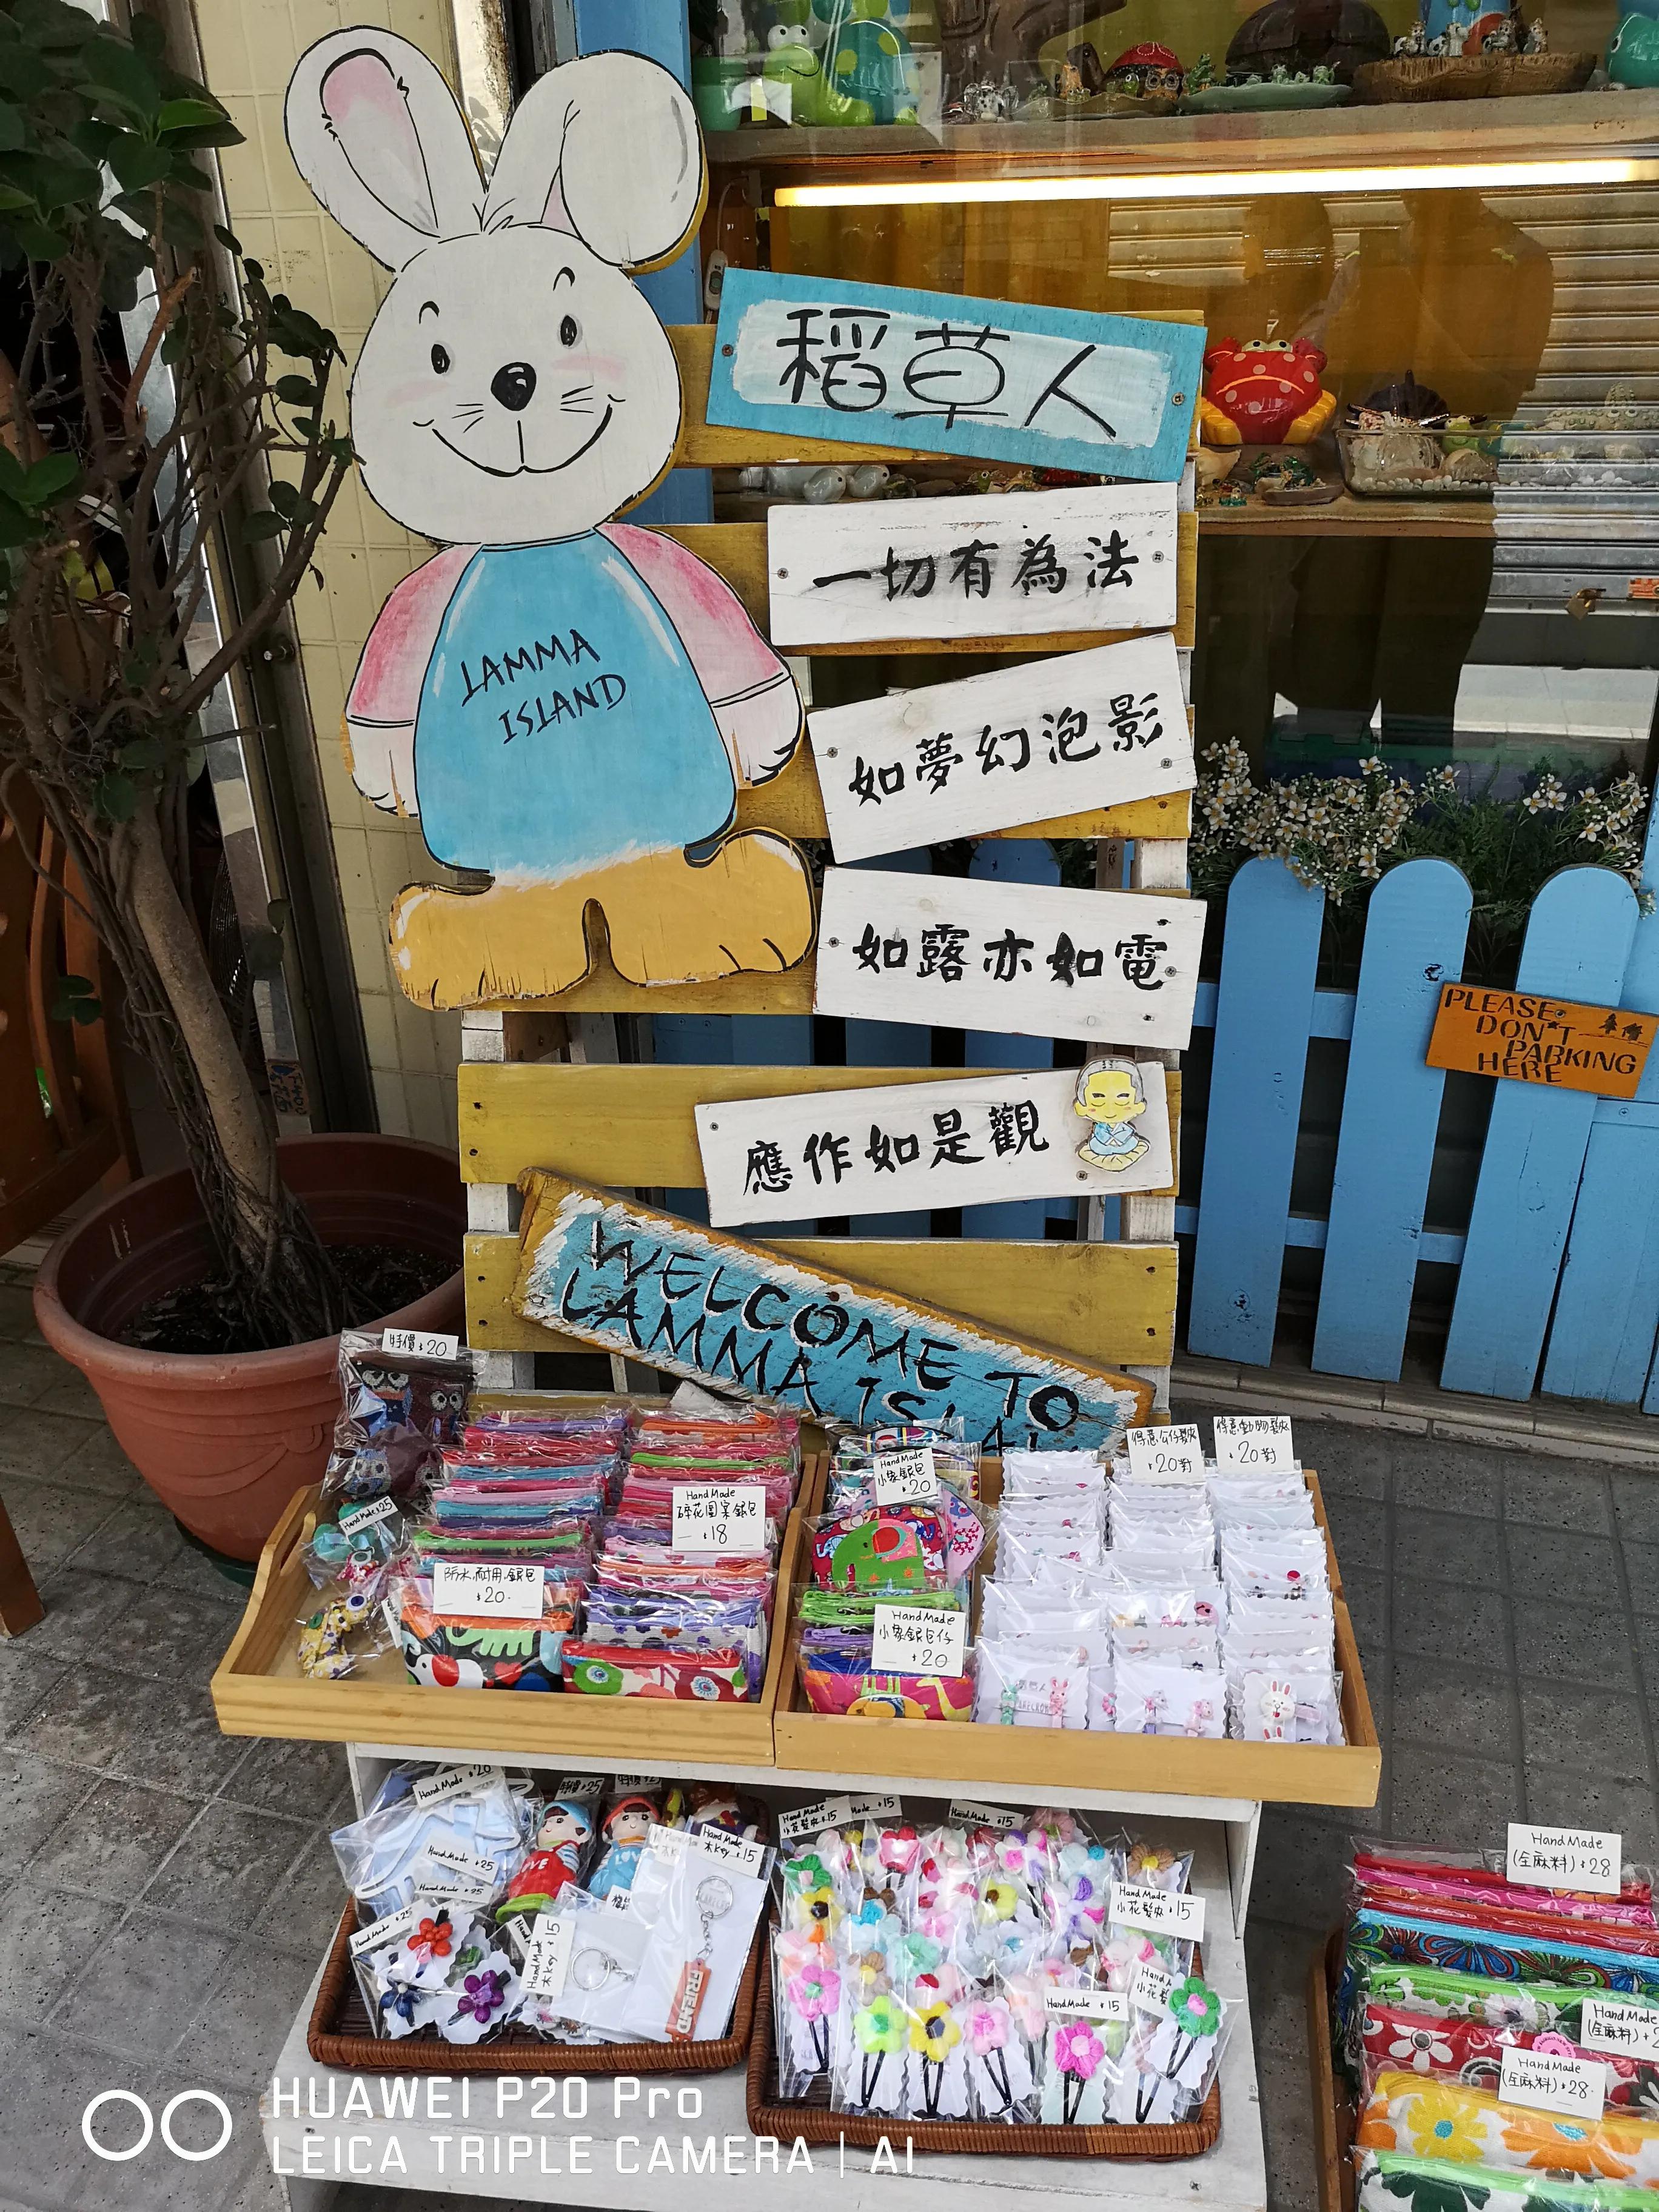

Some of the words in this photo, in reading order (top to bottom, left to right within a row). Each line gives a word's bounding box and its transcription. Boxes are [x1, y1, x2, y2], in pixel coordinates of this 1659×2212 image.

[776, 308, 1117, 439] 稻草人
[813, 529, 1139, 601] 一切有為法
[461, 629, 600, 707] LAMMA
[498, 674, 626, 744] ISLAND
[849, 693, 1163, 806] 如夢幻泡影
[853, 923, 1167, 990] 如露亦如電
[1444, 988, 1557, 1022] PLEASE
[1478, 1052, 1561, 1082] HERE
[1506, 1040, 1637, 1074] PARKING
[743, 1099, 1049, 1195] 應作如是觀
[560, 1268, 825, 1418] LAMMA
[589, 1220, 959, 1392] WELCOME
[984, 1370, 1080, 1432] TO
[390, 1334, 415, 1352] 特價
[419, 1339, 447, 1356] $20
[902, 1480, 931, 1495] $20
[703, 1524, 728, 1544] $18
[912, 1649, 948, 1668] $20
[521, 1858, 549, 1872] OVE
[615, 1851, 640, 1865] LOV
[1580, 1857, 1611, 1877] $28
[1168, 1900, 1195, 1920] $15
[1099, 2000, 1120, 2012] $15
